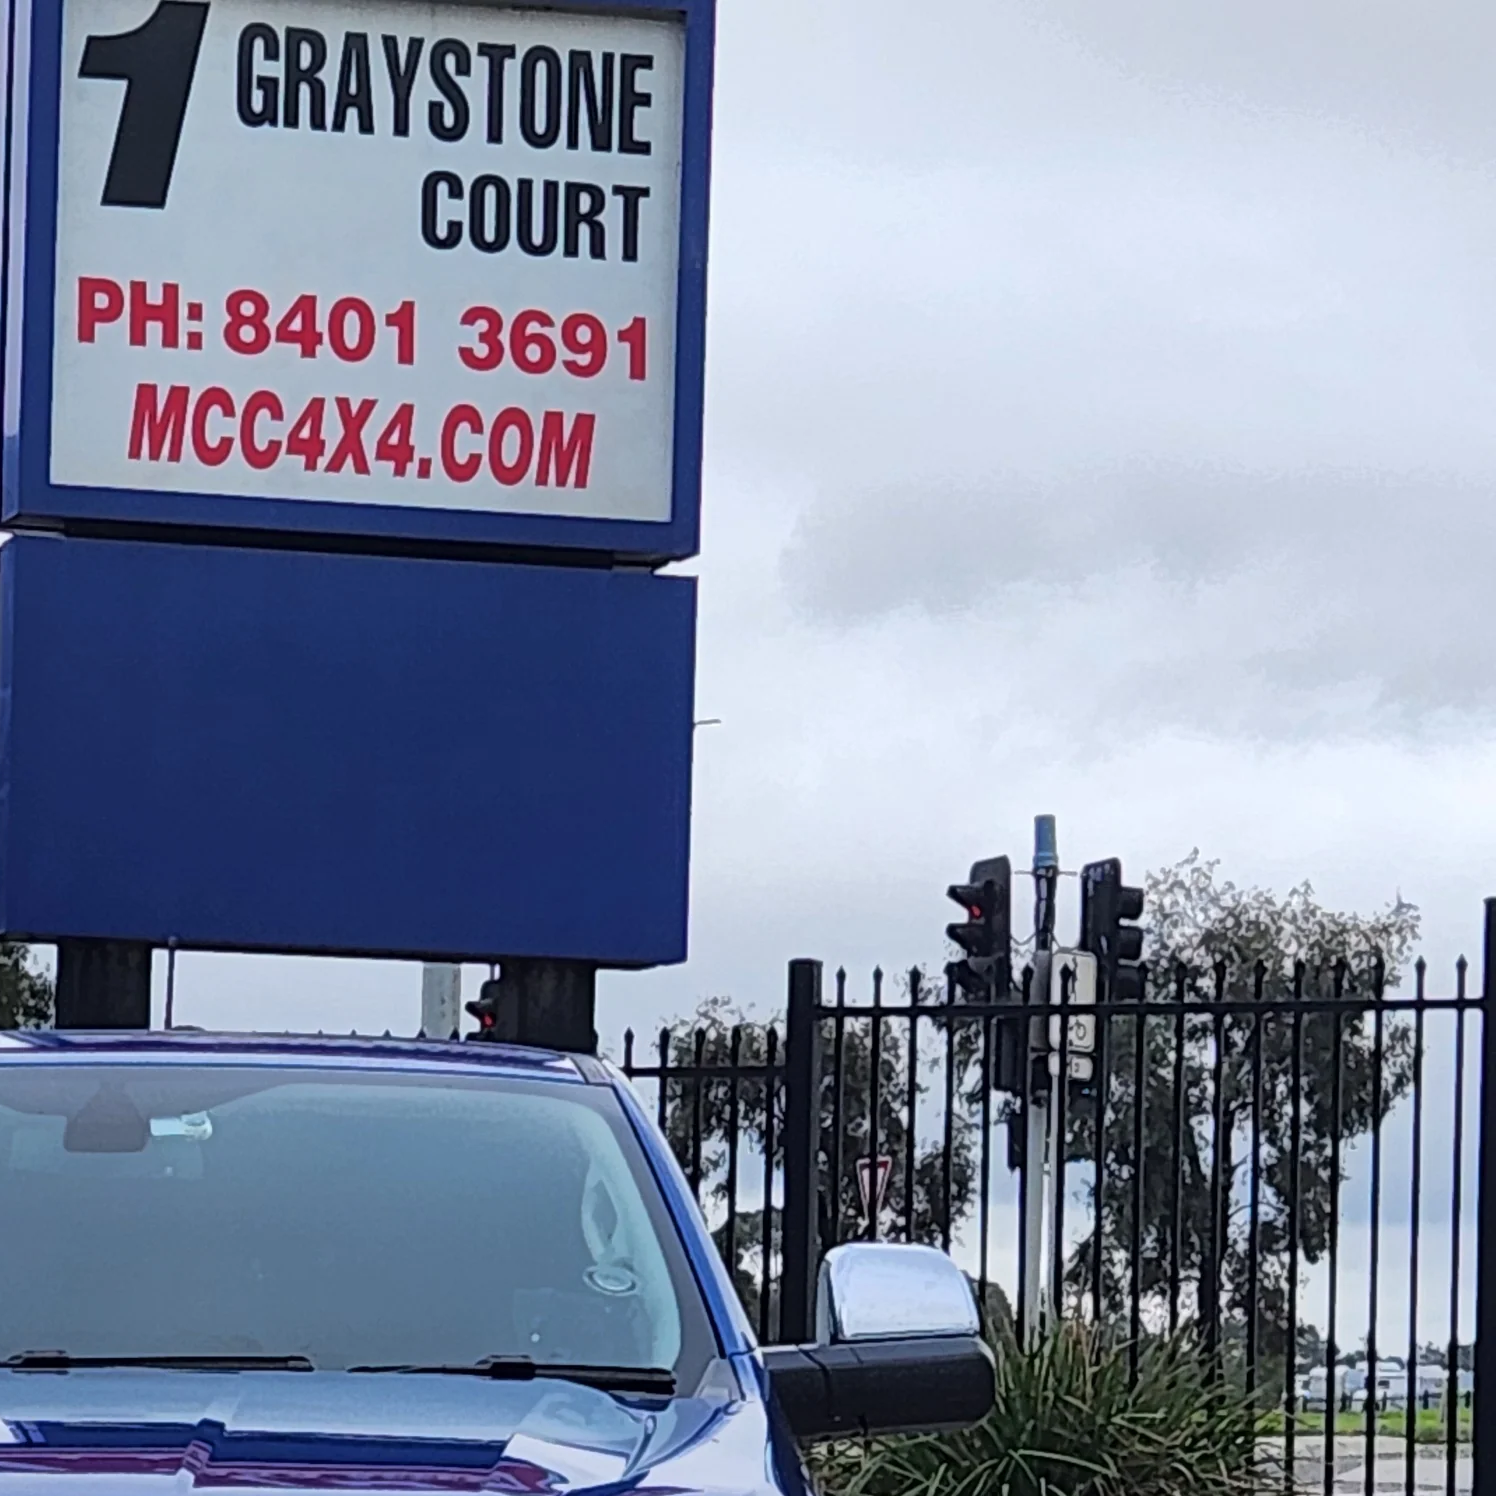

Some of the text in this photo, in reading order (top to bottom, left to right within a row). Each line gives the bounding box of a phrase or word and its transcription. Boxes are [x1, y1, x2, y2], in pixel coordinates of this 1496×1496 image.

[77, 0, 654, 209] 1 GRAYSTONE
[420, 169, 651, 262] COURT
[77, 276, 648, 381] PH: 8401 3691
[127, 382, 596, 489] MCC4X4.COM
